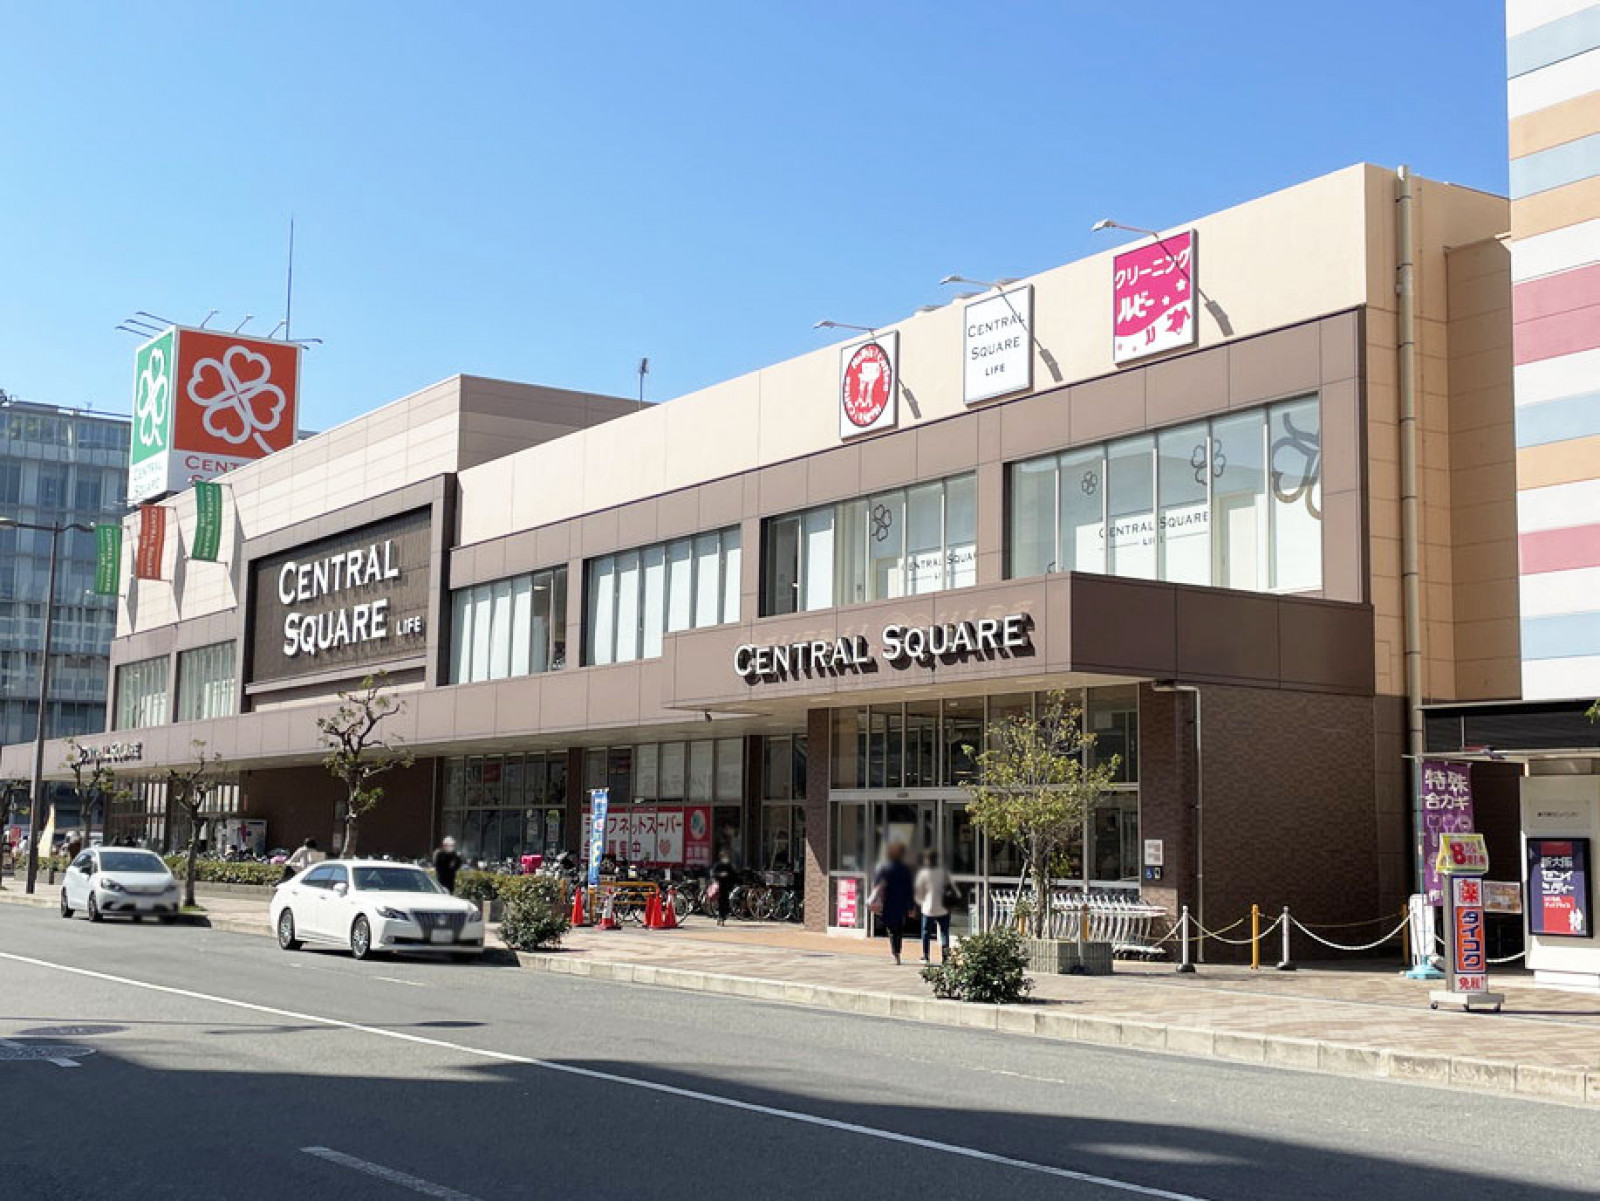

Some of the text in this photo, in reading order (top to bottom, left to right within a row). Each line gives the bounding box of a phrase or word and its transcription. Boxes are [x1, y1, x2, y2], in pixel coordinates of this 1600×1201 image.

[1115, 247, 1191, 290] クリーニング
[1117, 290, 1155, 324] ルビー
[968, 312, 1025, 338] CENTRAL
[971, 336, 1020, 361] SQUARE
[985, 363, 1006, 377] LIFE
[184, 455, 241, 473] CENT
[1160, 511, 1208, 530] SQUARE
[278, 539, 399, 605] CENTRAL
[283, 598, 422, 657] SQUARE LIFE
[734, 613, 1030, 677] CENTRAL SQUARE
[1424, 768, 1470, 796] 特殊
